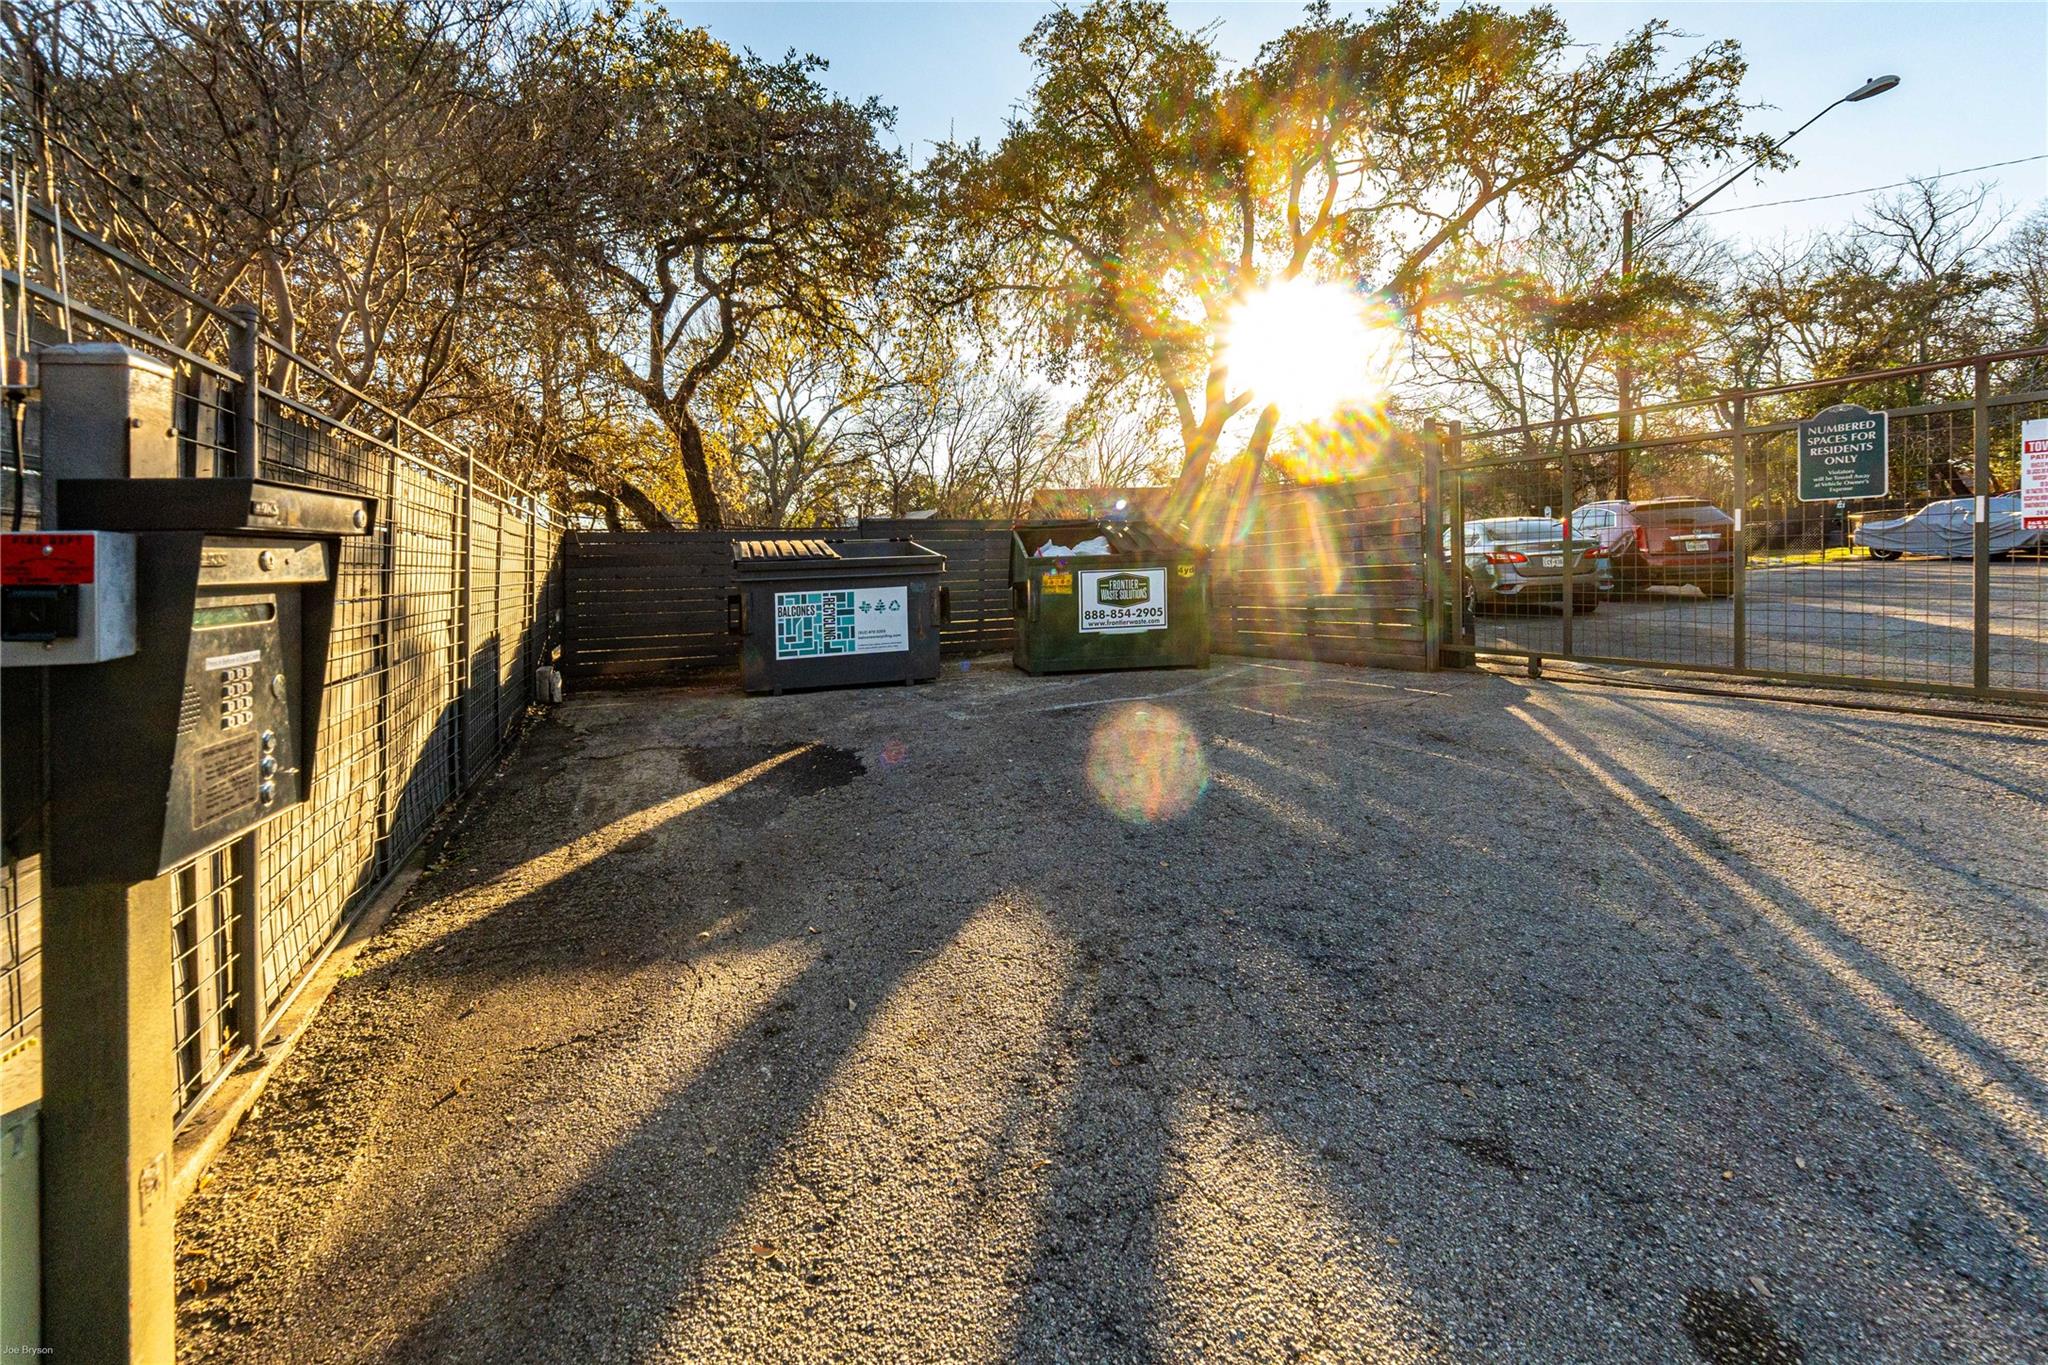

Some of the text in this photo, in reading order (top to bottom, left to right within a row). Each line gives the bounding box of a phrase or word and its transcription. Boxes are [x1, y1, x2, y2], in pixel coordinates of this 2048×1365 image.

[1807, 420, 1877, 436] NUMBERED
[1807, 431, 1877, 446] SPACES FOR
[1810, 442, 1874, 456] RESIDENTS
[1824, 454, 1858, 465] ONLY
[1109, 579, 1139, 591] FRONTIER
[1100, 586, 1148, 601] WASTE SOLUTIONS
[777, 604, 816, 618] BALCONES
[1084, 607, 1164, 620] 888-854-2905
[822, 597, 836, 641] RECYCLING
[1088, 618, 1161, 627] www.frontierwaste.com
